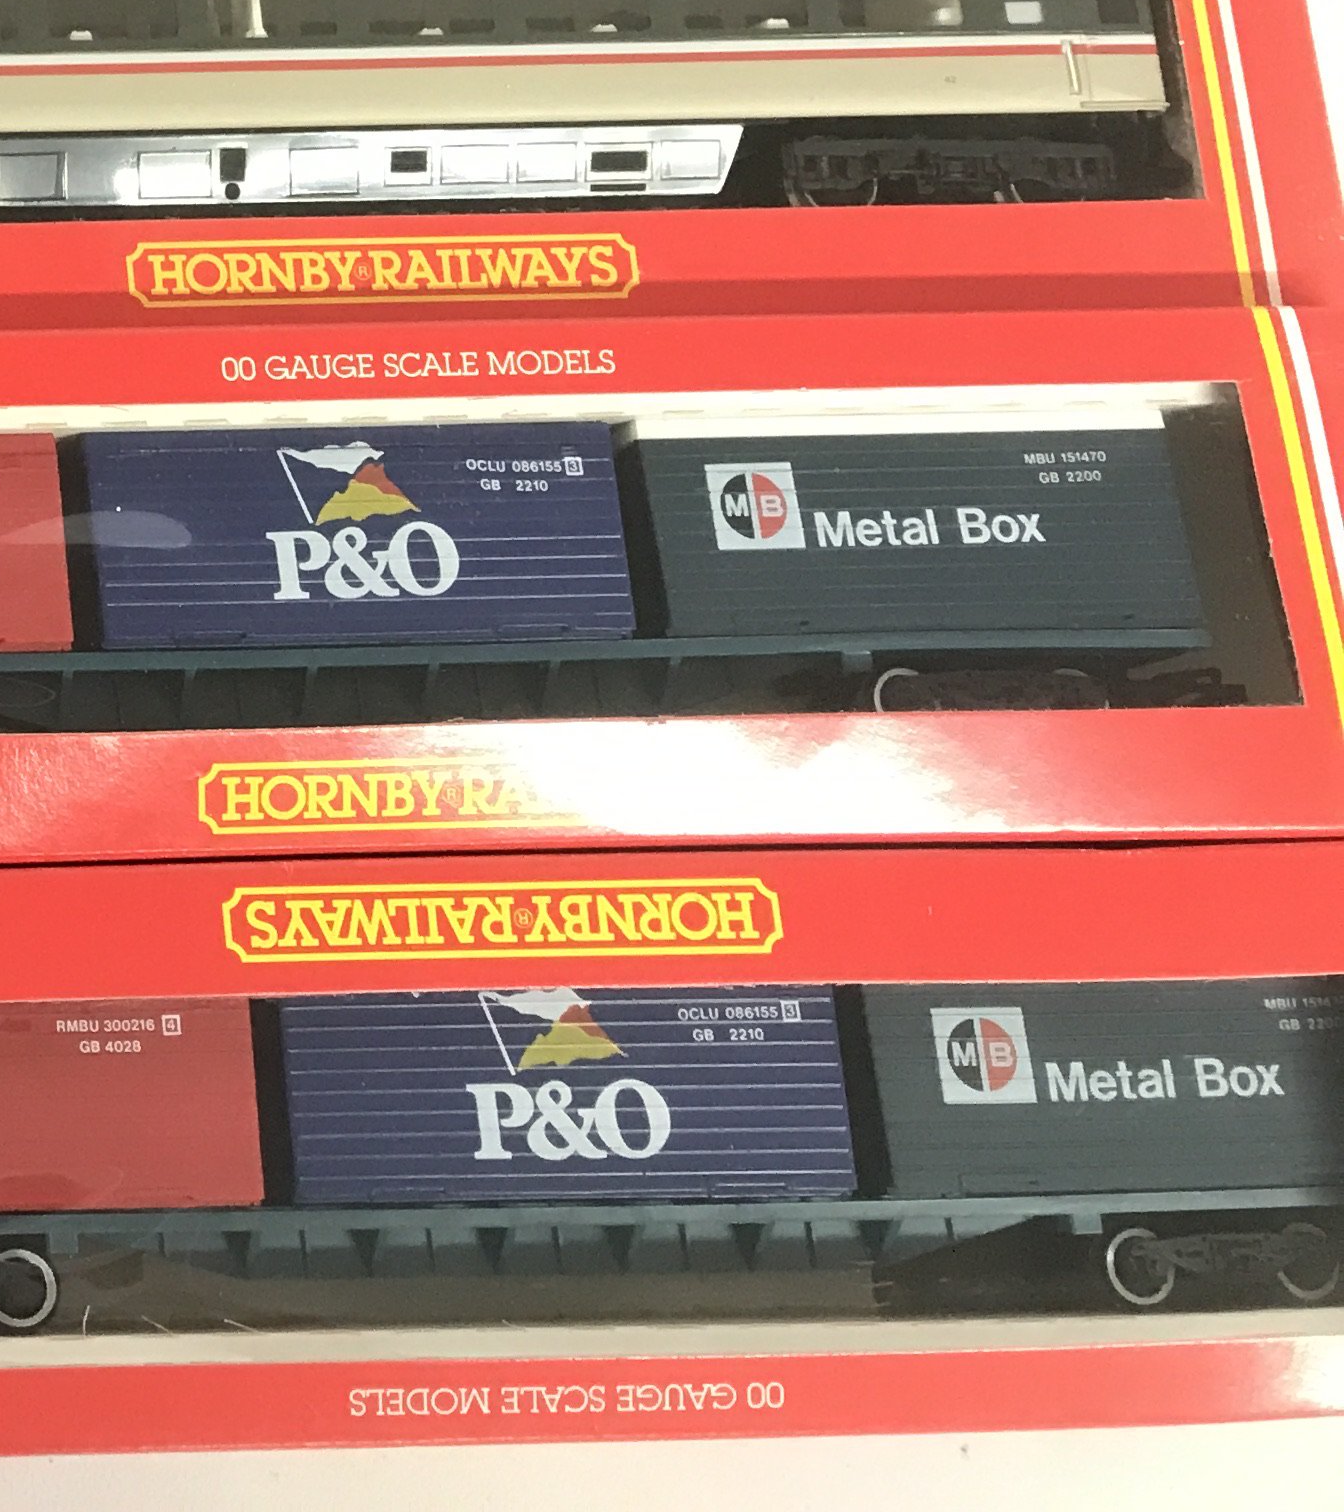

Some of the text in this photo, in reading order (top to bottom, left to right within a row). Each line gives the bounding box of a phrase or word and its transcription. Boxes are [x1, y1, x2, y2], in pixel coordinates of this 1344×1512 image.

[369, 246, 617, 289] RAILWAYS
[264, 353, 376, 380] GAUGE
[383, 351, 480, 378] SCALE
[486, 349, 616, 376] MODELS
[465, 459, 506, 473] OCLU
[512, 459, 563, 473] 086155
[1023, 450, 1107, 465] MBU 151470
[480, 478, 549, 492] GB 2210
[1038, 470, 1102, 484] GB 2200
[813, 506, 1047, 548] Metal Box
[265, 520, 460, 601] P&O
[247, 897, 517, 948] RAILWAYS
[56, 1019, 100, 1033] RMBU
[103, 1018, 155, 1032] 300216
[677, 1007, 719, 1021] OCLU
[725, 1006, 779, 1019] 086155
[79, 1039, 142, 1054] GB 4028
[692, 1027, 764, 1041] GB 2210
[1044, 1056, 1286, 1103] Metal Box
[465, 1078, 672, 1161] P&O
[349, 1387, 491, 1417] MODELS
[501, 1385, 606, 1414] SCALE
[615, 1382, 737, 1412] GAUGE
